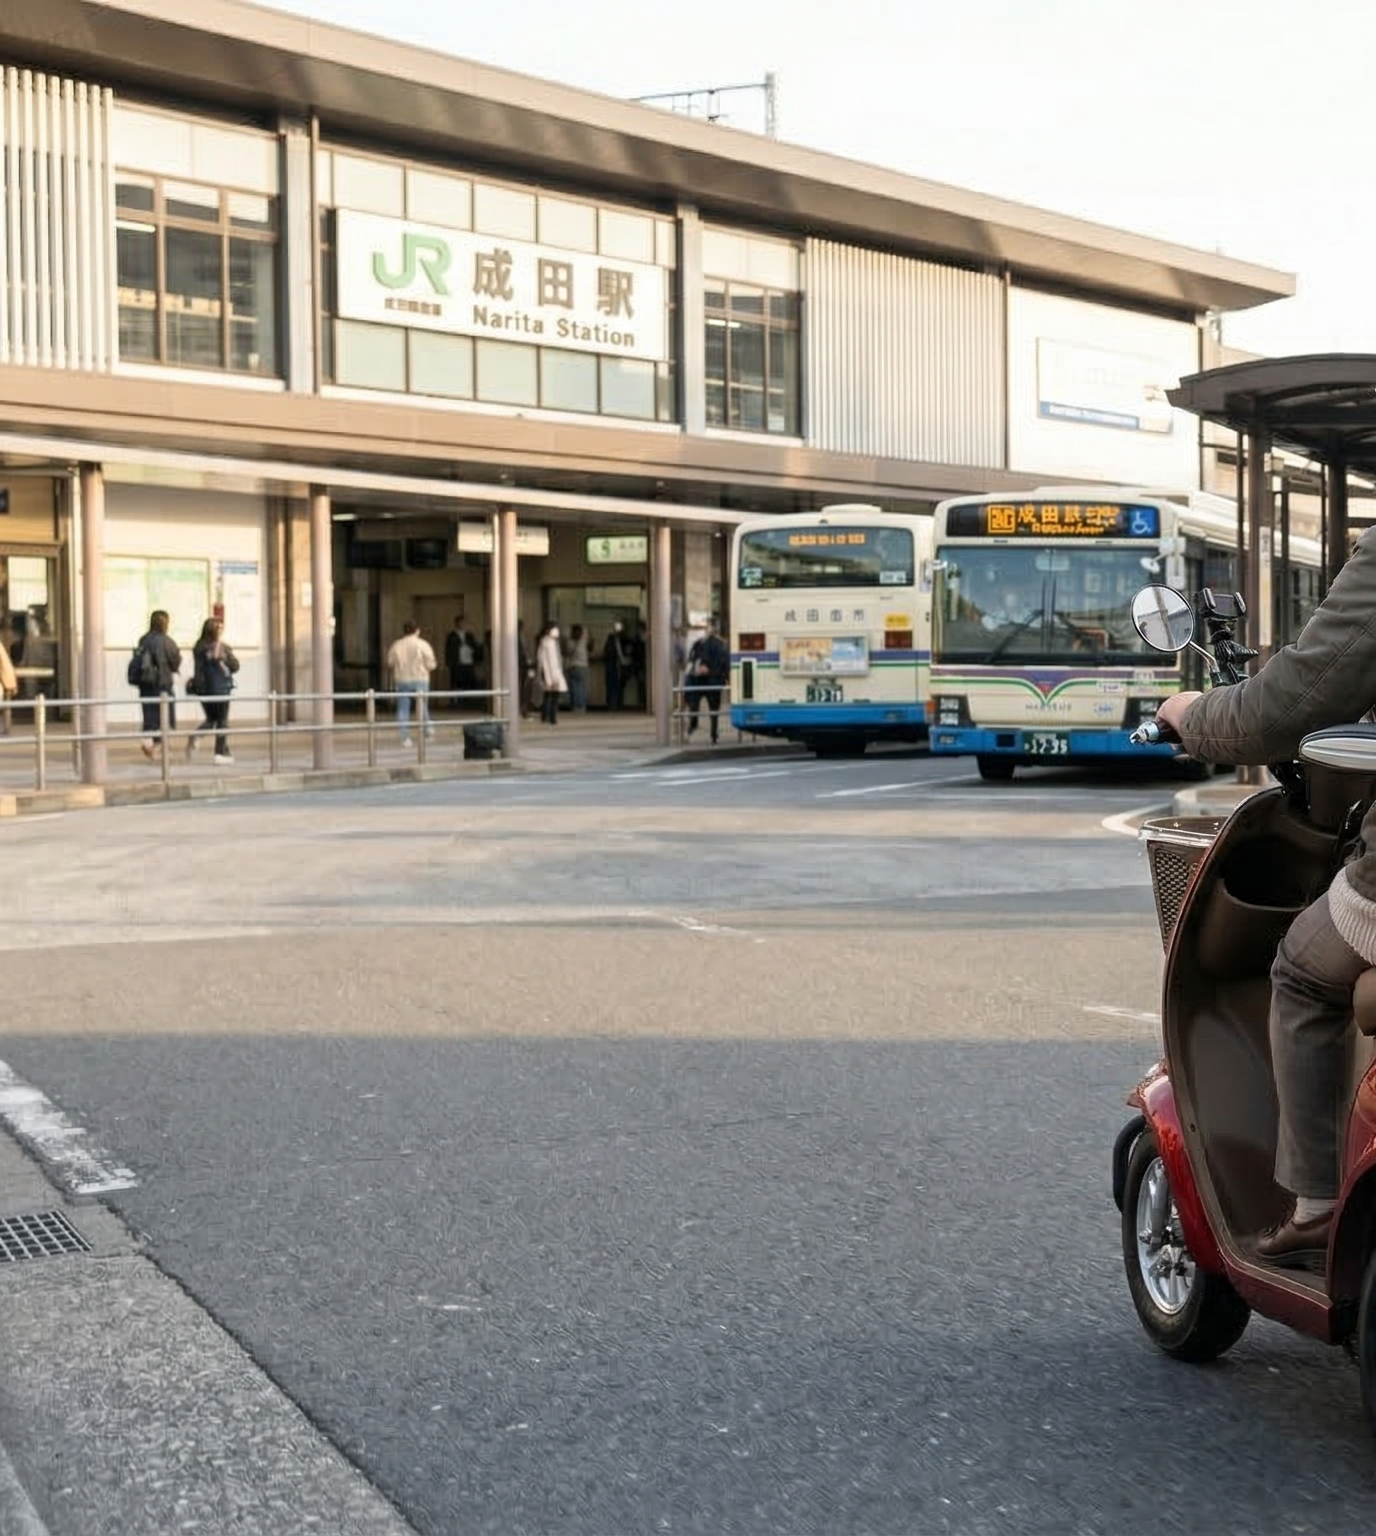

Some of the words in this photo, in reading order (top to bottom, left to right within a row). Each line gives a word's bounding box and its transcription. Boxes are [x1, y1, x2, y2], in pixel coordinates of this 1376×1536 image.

[371, 232, 453, 297] JR
[472, 247, 636, 320] 成田駅
[472, 304, 545, 335] Narita
[556, 317, 636, 348] Station
